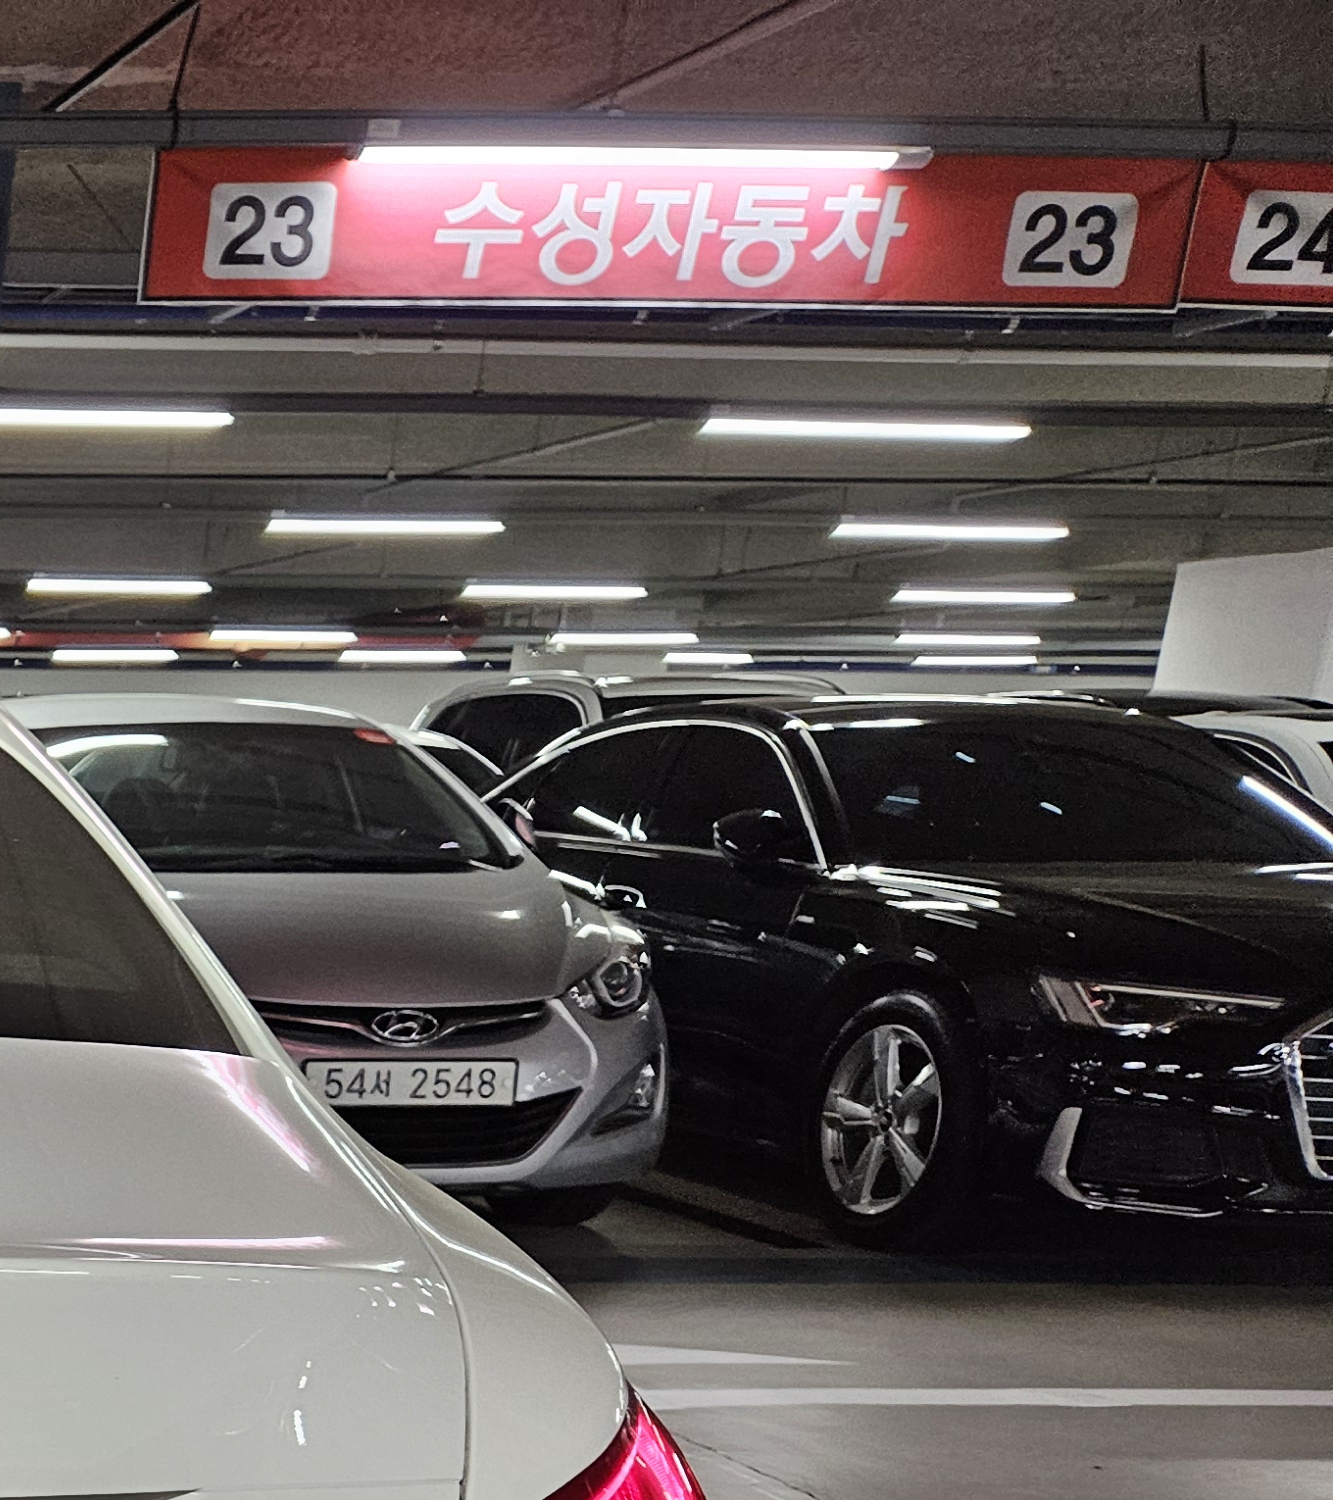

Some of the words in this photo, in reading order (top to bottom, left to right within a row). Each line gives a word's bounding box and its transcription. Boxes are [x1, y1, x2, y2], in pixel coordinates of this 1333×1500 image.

[219, 195, 313, 267] 23
[434, 180, 908, 288] 수성자동차
[1017, 203, 1118, 276] 23
[324, 1067, 391, 1099] 54서
[409, 1068, 496, 1099] 2548
